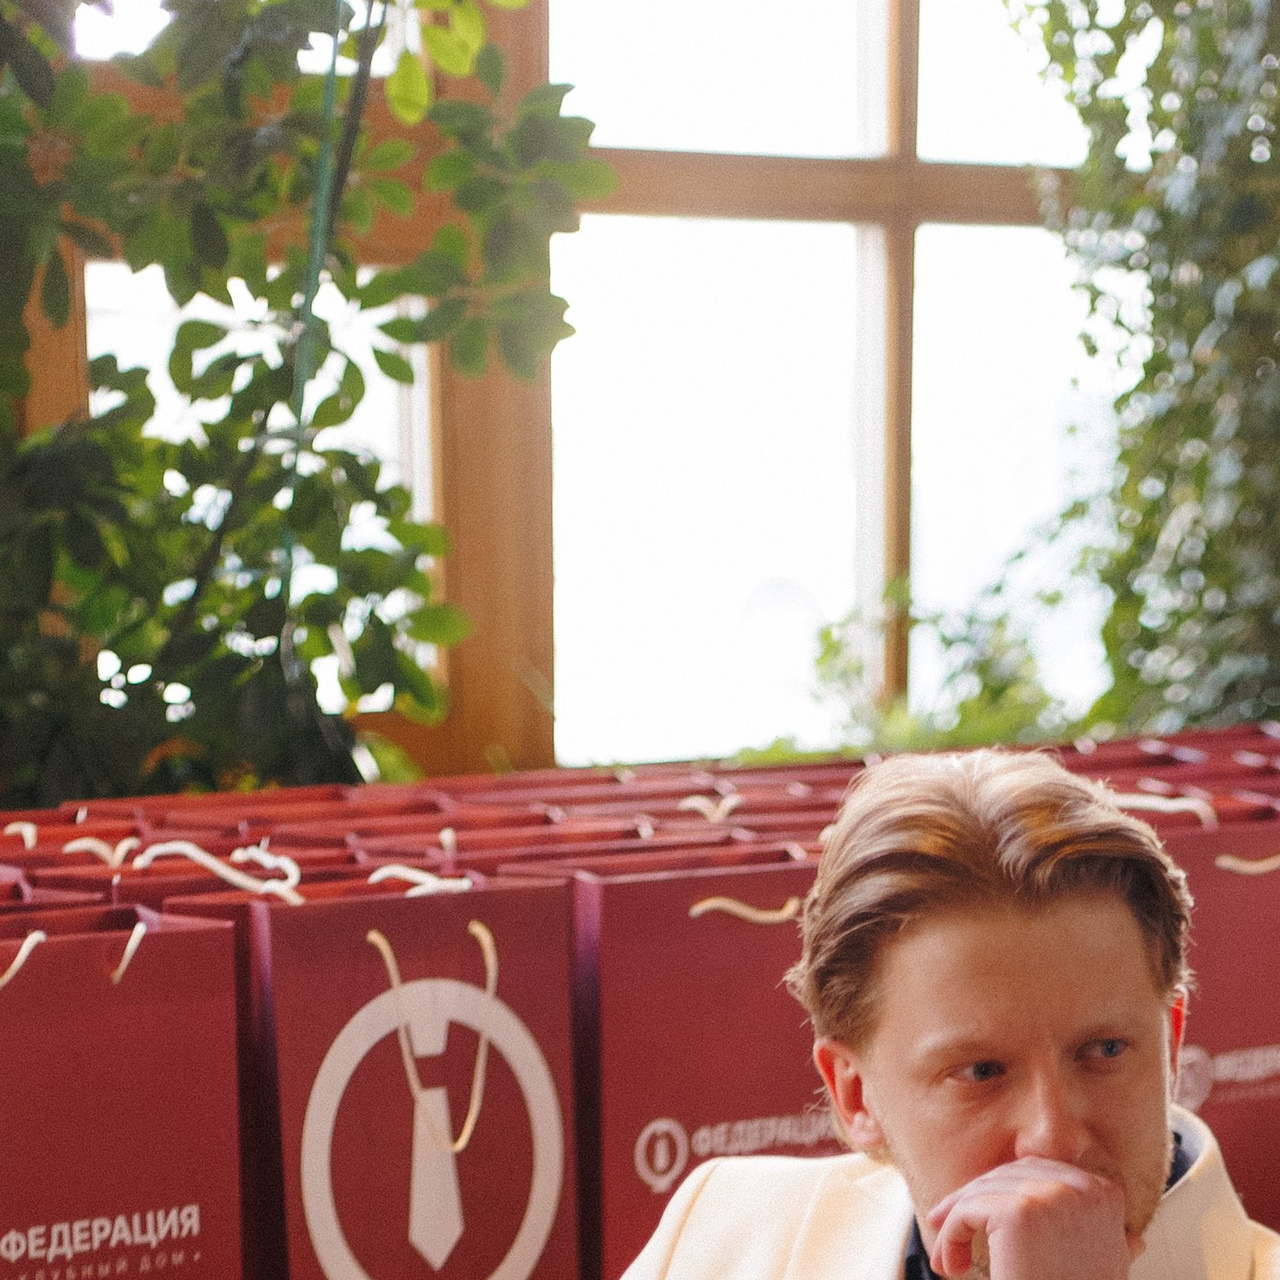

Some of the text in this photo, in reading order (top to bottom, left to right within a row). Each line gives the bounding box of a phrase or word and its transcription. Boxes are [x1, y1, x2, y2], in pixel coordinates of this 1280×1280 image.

[691, 1110, 836, 1156] ФЕДЕРАЦИ
[0, 1203, 200, 1264] ФЕДЕРАЦИЯ
[138, 1250, 185, 1273] ДОМ
